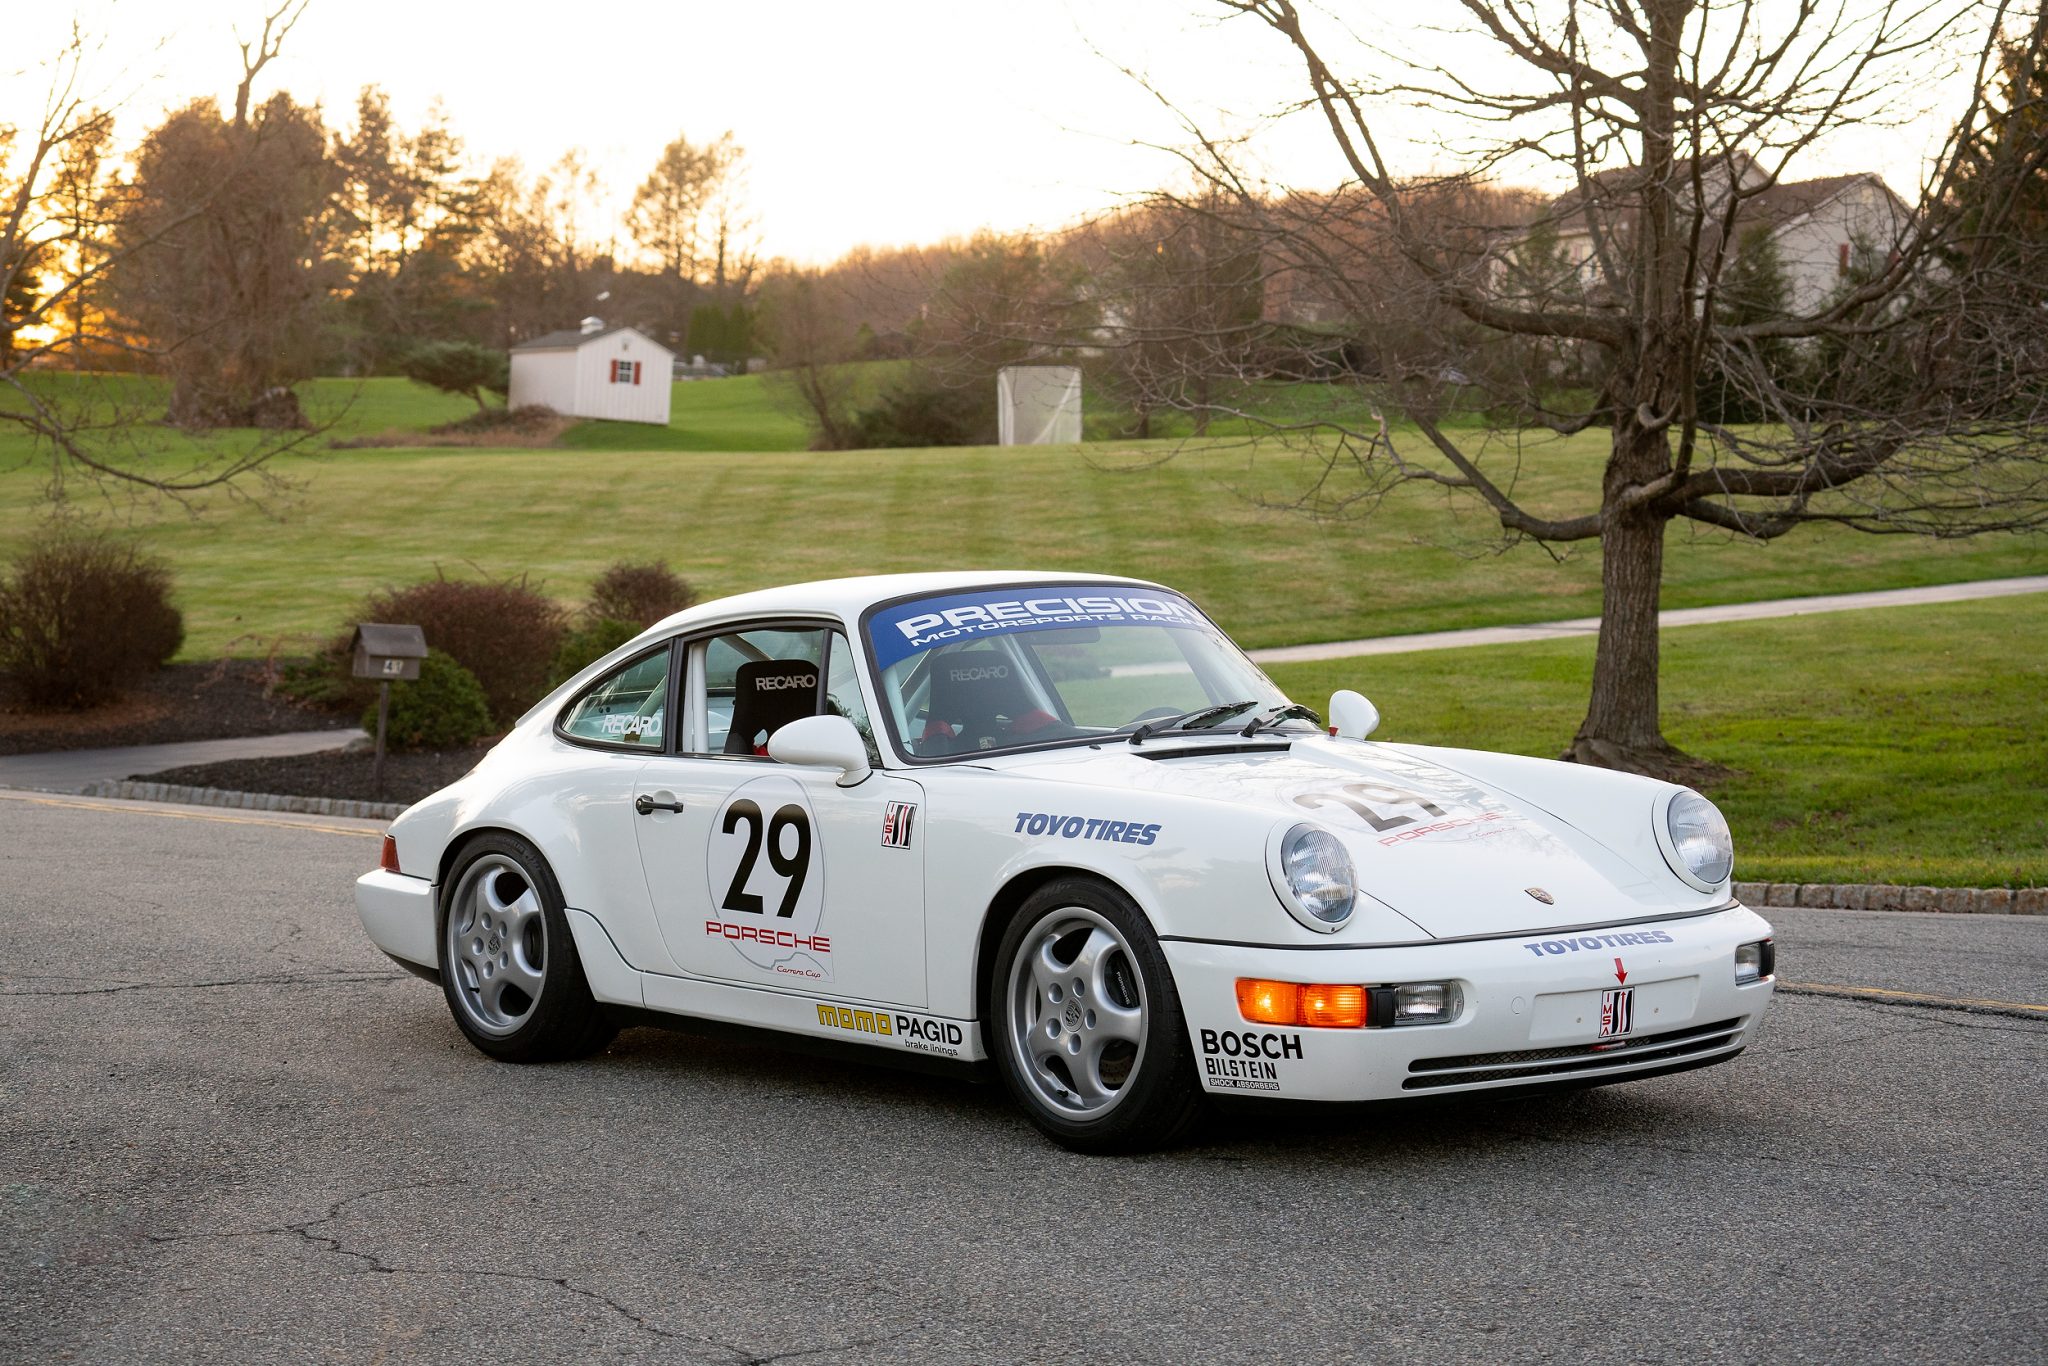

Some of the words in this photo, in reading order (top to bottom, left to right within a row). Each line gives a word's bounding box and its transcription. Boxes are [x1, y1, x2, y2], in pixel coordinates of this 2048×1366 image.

[896, 597, 1204, 639] PRECISION
[911, 614, 1125, 646] MOTORSPORTS
[1130, 614, 1208, 628] RACIN
[755, 674, 817, 691] RECARO
[951, 665, 1009, 681] RECARO
[602, 714, 662, 736] RECARO
[1292, 783, 1449, 832] 29
[1377, 812, 1504, 847] PORSCHE
[721, 798, 811, 918] 29
[706, 920, 831, 952] PORSCHE
[776, 965, 804, 976] Carrera
[805, 969, 821, 978] Cup
[896, 1014, 963, 1046] PAGID
[1200, 1028, 1304, 1060] BOSCH
[904, 1038, 929, 1051] brake
[930, 1043, 958, 1057] linings
[1205, 1057, 1278, 1080] BILSTEIN
[1210, 1078, 1235, 1088] SHOCK
[1236, 1080, 1279, 1090] ABSORBERS
